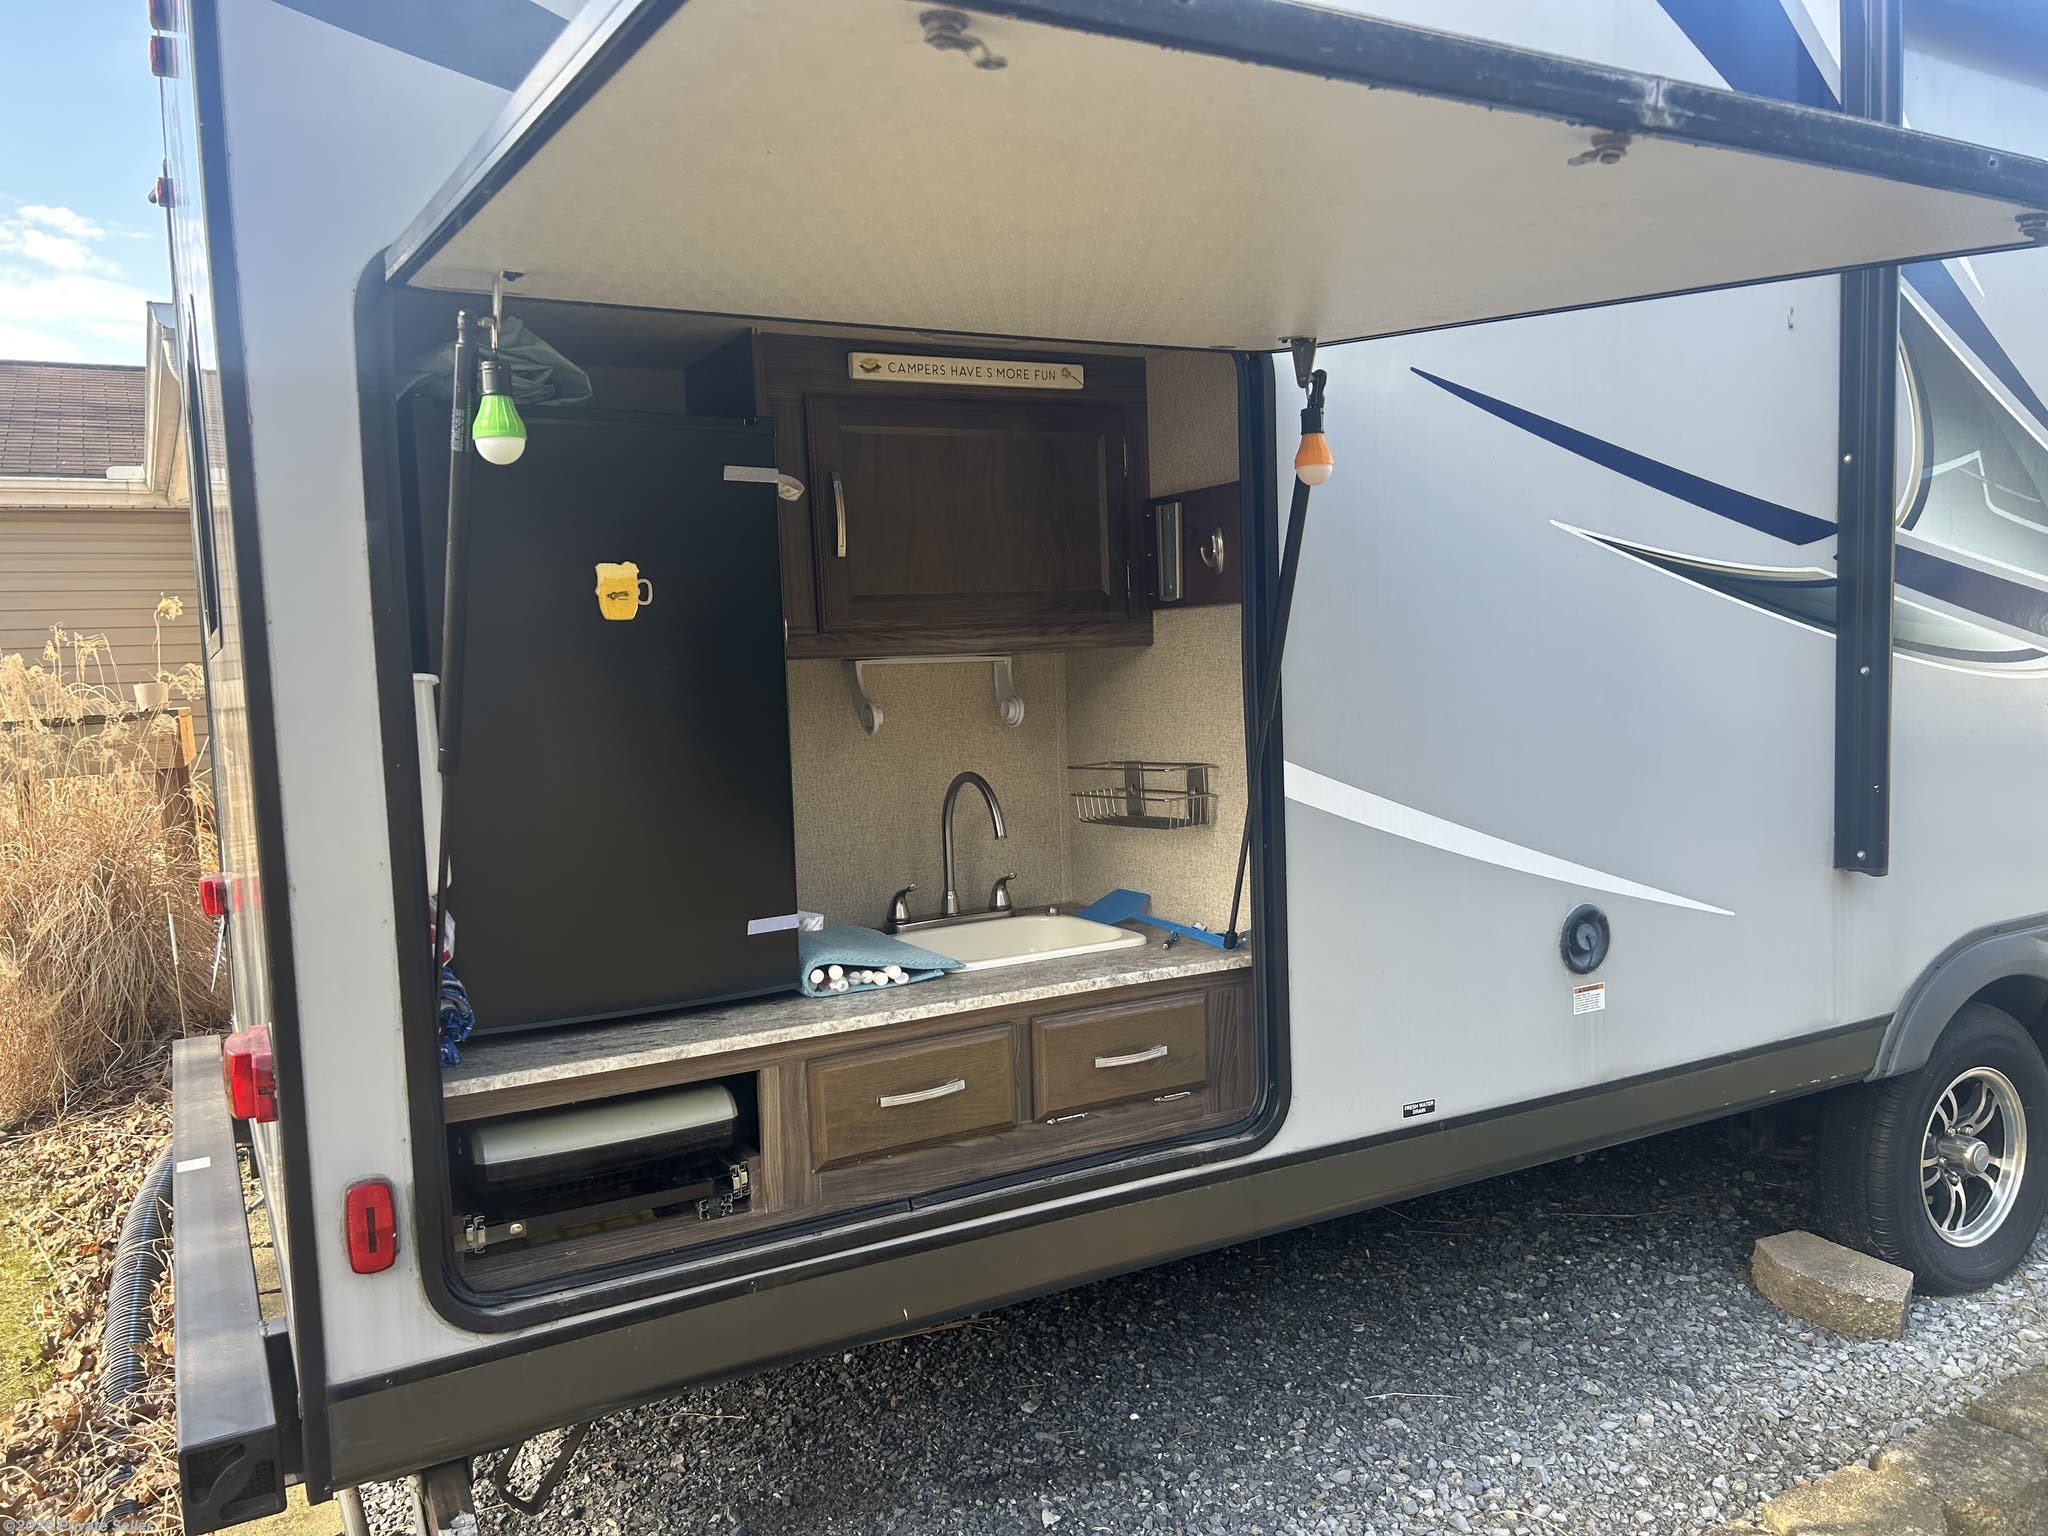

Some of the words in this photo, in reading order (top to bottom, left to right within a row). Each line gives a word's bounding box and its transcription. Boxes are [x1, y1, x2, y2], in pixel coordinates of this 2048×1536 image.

[887, 361, 946, 376] CAMPERS
[950, 365, 983, 378] HAVE
[1034, 369, 1056, 381] FUN
